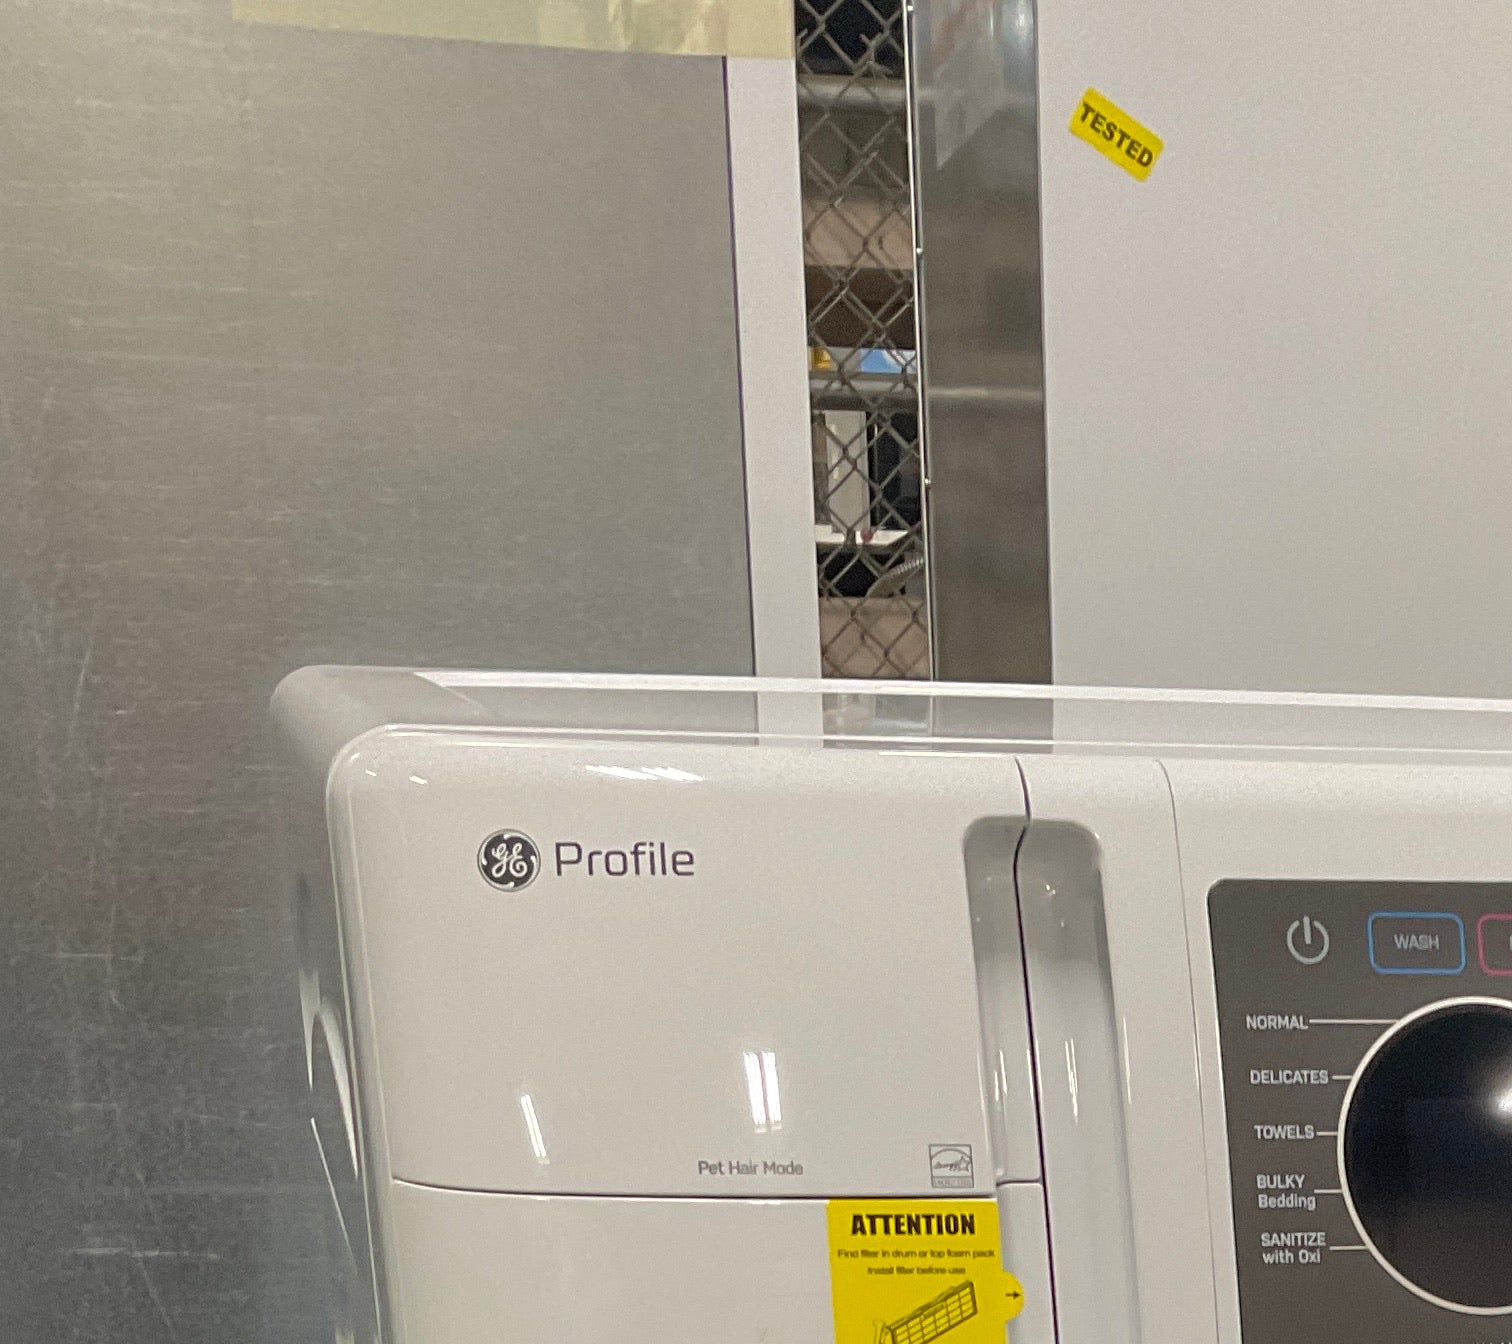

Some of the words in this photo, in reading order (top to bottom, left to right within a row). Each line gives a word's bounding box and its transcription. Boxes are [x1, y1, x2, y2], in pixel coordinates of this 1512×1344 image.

[1080, 102, 1153, 168] TESTED
[555, 841, 695, 877] Profile
[1394, 934, 1440, 951] WASH
[1246, 1014, 1309, 1030] NORMAL
[1250, 1069, 1329, 1085] DELICATES
[1254, 1124, 1315, 1140] TOWELS
[698, 1160, 725, 1175] Pet
[728, 1159, 760, 1175] Hair
[761, 1159, 804, 1175] Mode
[1256, 1173, 1305, 1189] BULKY
[1257, 1193, 1317, 1212] Bedding
[850, 1213, 976, 1236] ATTENTION
[1261, 1231, 1326, 1247] SANITIZE
[837, 1249, 859, 1258] Find
[880, 1249, 890, 1258] in
[891, 1249, 917, 1258] drum
[918, 1250, 928, 1258] or
[930, 1249, 944, 1260] top
[946, 1249, 971, 1258] foam
[972, 1249, 995, 1260] pack
[1262, 1248, 1294, 1264] with
[1298, 1248, 1321, 1264] Oxi
[867, 1266, 894, 1275] Install
[916, 1266, 946, 1275] before
[947, 1267, 967, 1275] use
